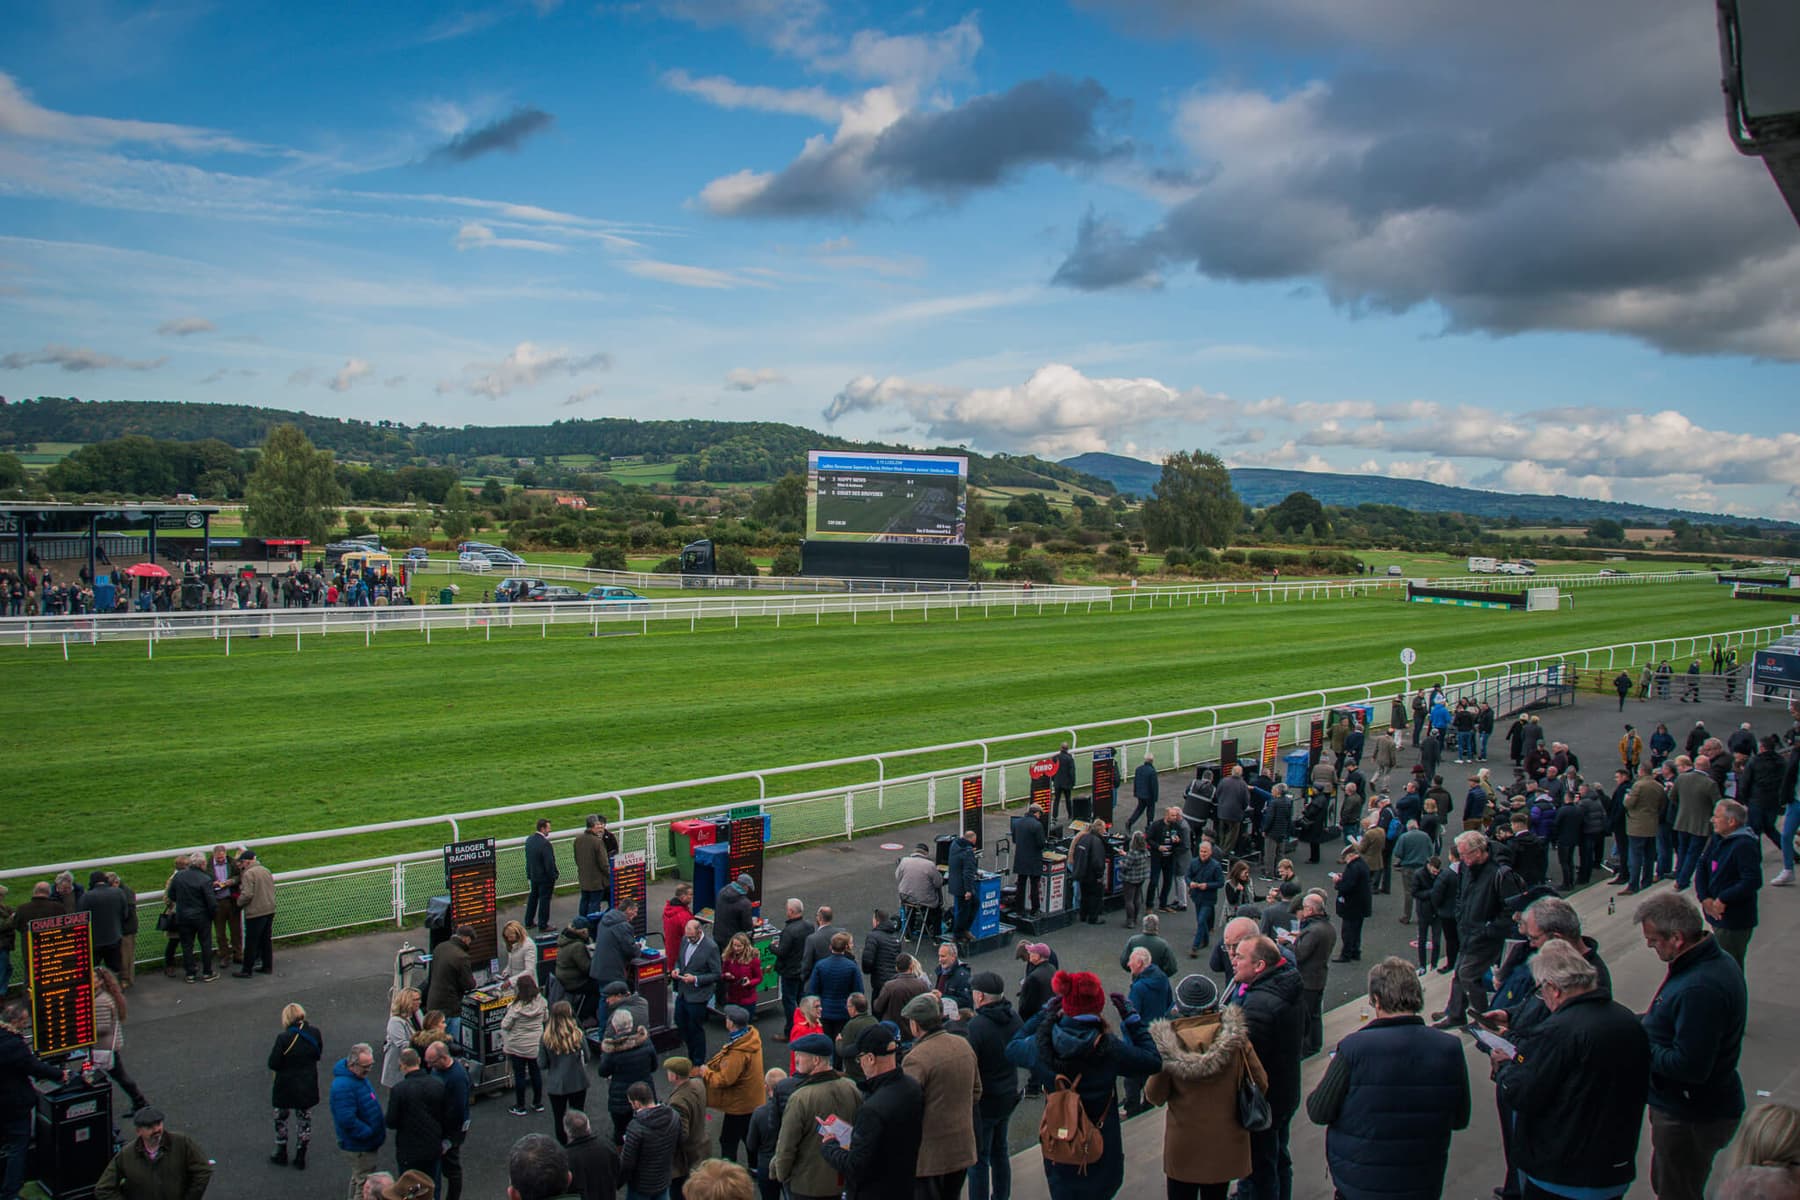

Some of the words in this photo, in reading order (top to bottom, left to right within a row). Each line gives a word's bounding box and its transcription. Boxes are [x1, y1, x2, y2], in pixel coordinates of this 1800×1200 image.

[455, 843, 485, 854] BADGER
[449, 852, 477, 863] RACING
[477, 850, 491, 858] LTD
[32, 917, 62, 931] CHARLIE
[64, 912, 88, 926] CHASE
